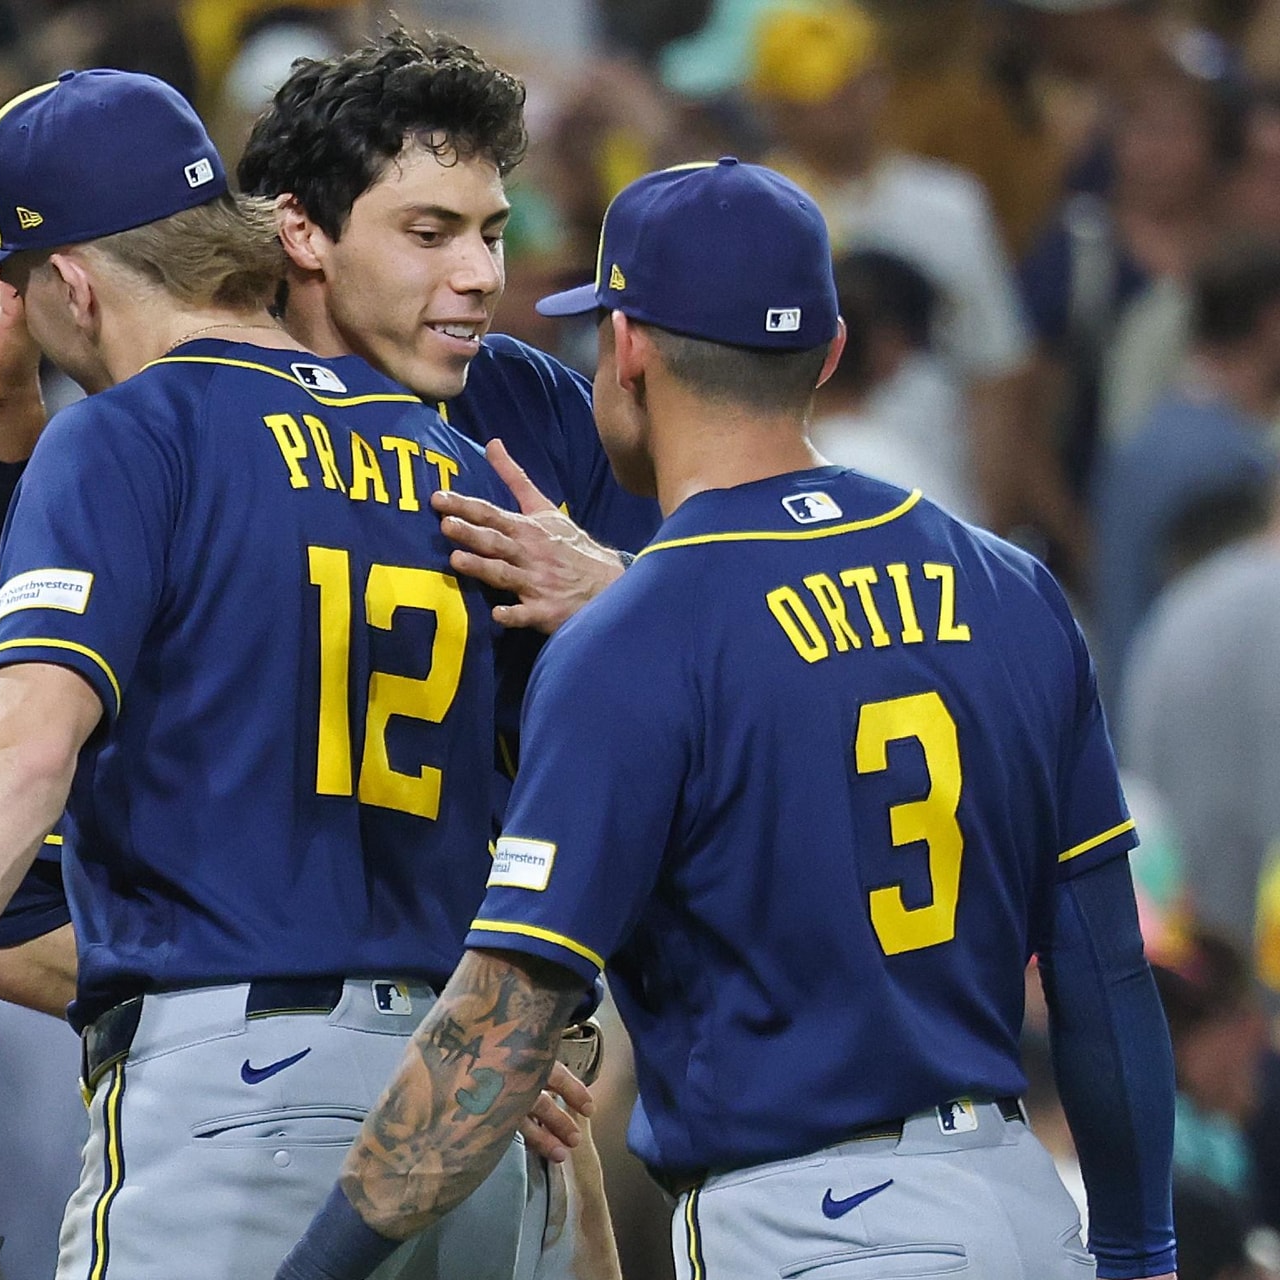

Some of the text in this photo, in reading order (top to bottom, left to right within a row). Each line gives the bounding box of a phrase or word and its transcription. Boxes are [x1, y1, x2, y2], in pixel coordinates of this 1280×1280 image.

[263, 413, 458, 511] PRATT
[307, 545, 468, 821] 12
[766, 563, 971, 663] ORTIZ
[855, 691, 964, 956] 3
